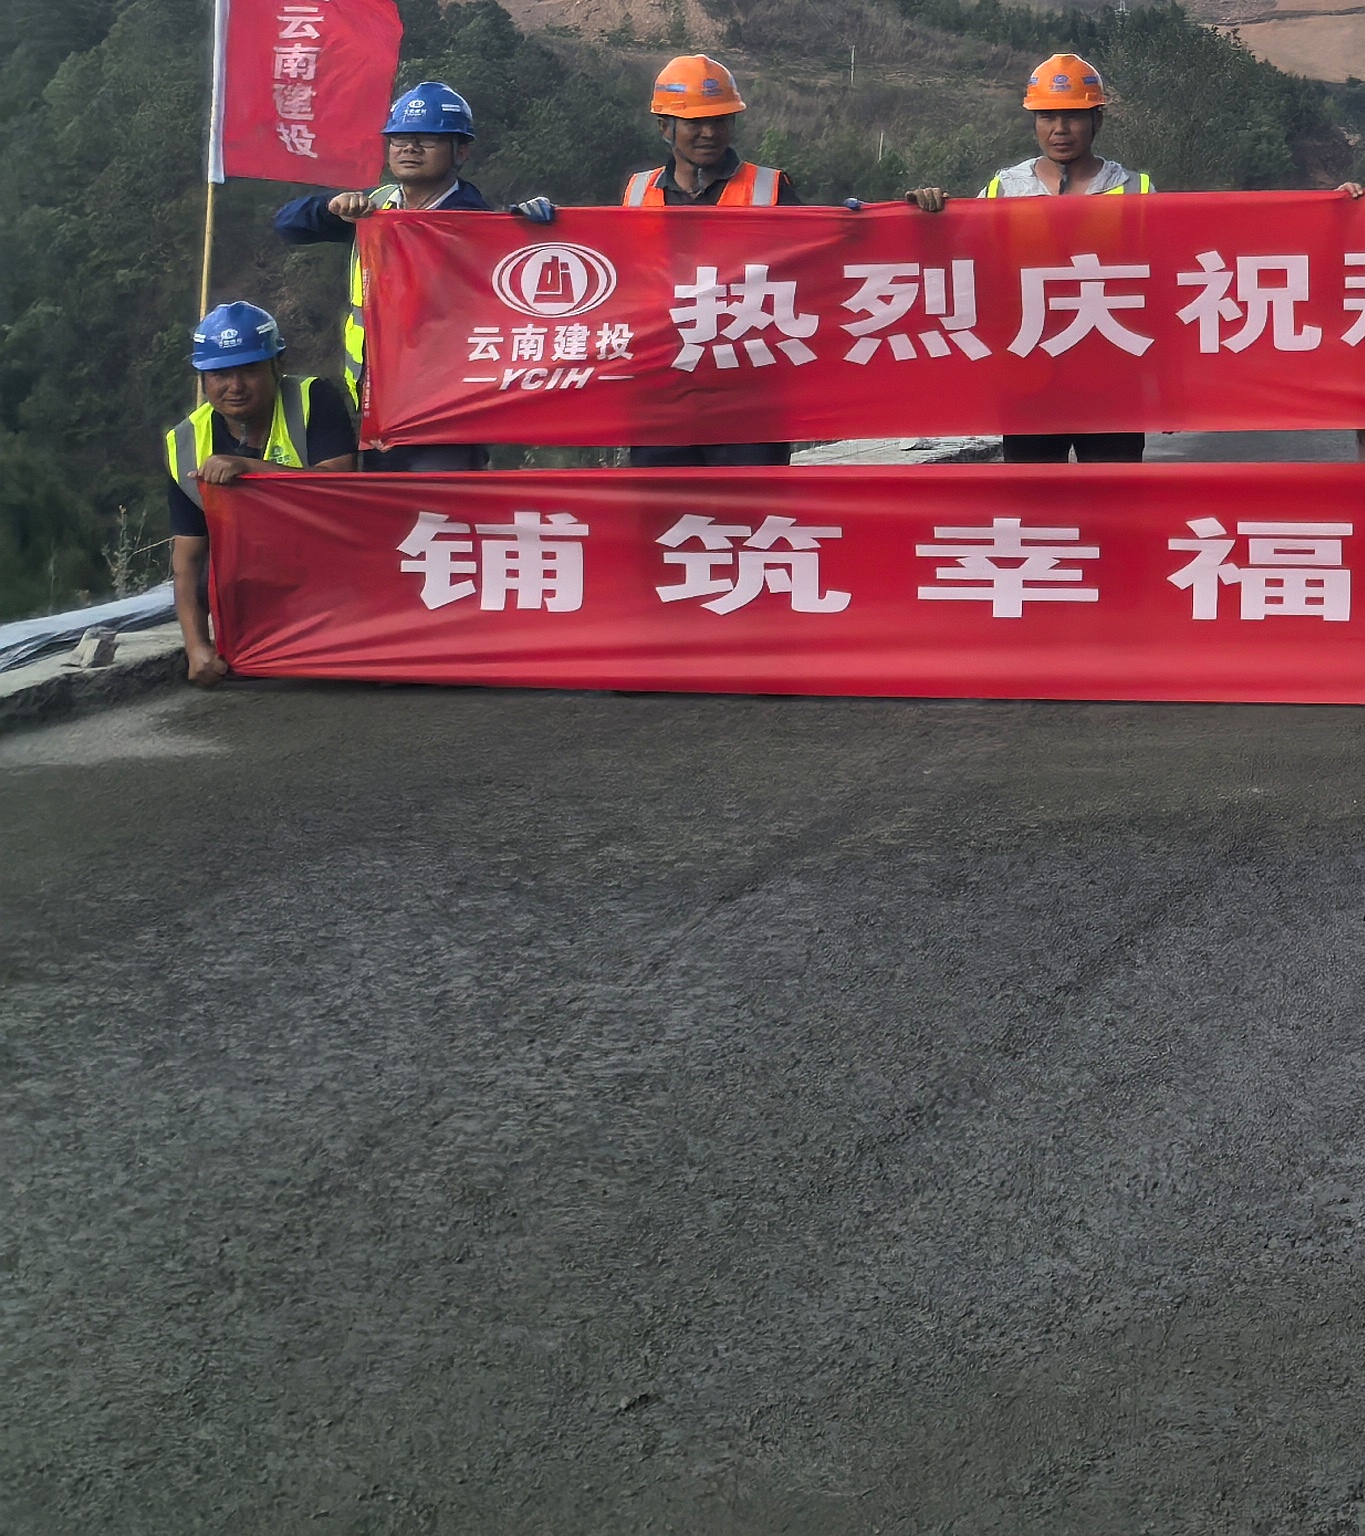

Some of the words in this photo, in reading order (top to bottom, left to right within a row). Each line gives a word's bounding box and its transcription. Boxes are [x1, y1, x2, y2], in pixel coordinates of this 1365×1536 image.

[272, 5, 326, 159] 云南建投
[467, 322, 635, 363] 云南建投
[499, 366, 595, 391] YCIH
